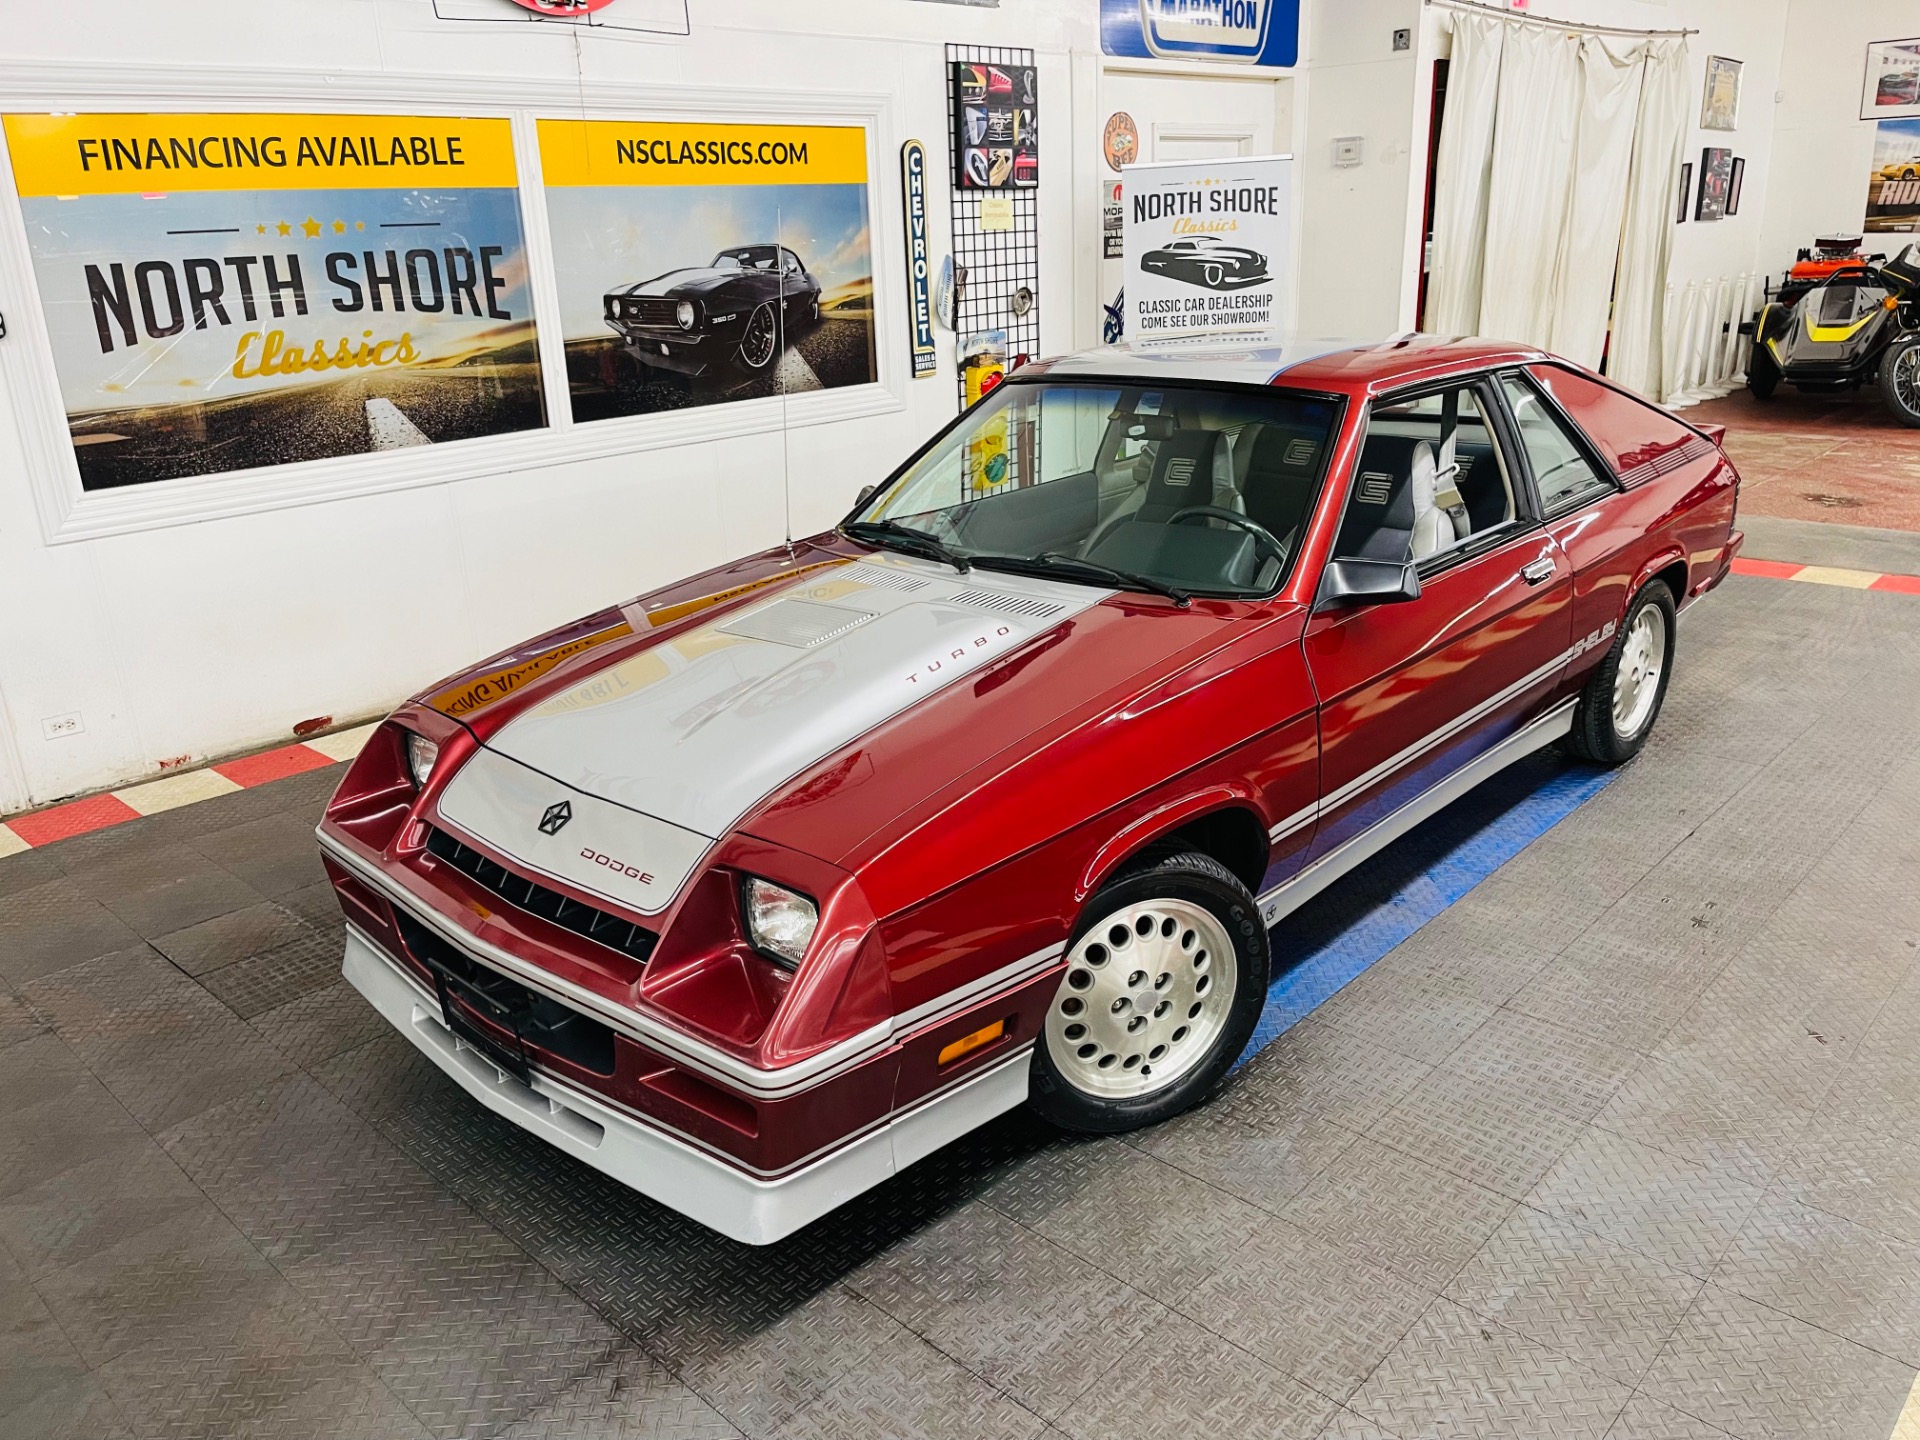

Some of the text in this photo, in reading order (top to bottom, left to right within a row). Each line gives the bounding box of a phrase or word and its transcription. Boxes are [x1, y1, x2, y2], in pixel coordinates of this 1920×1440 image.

[78, 136, 466, 172] FINANCING AVAILABLE
[616, 139, 809, 165] NSCLASSICS.COM
[1133, 186, 1278, 224] NORTH SHORE
[1172, 217, 1239, 235] Classics
[909, 152, 928, 343] CHEVROLET
[84, 246, 512, 354] NORTH SHORE
[1139, 294, 1273, 314] CLASSIC CAR DEALERSHIP
[1141, 311, 1270, 329] COME SEE OUR SHOWROOM!
[232, 328, 421, 380] Classics
[914, 353, 930, 363] SALES
[905, 626, 1010, 683] TURBO
[1572, 618, 1618, 660] SHELBY
[580, 847, 655, 885] DODGE
